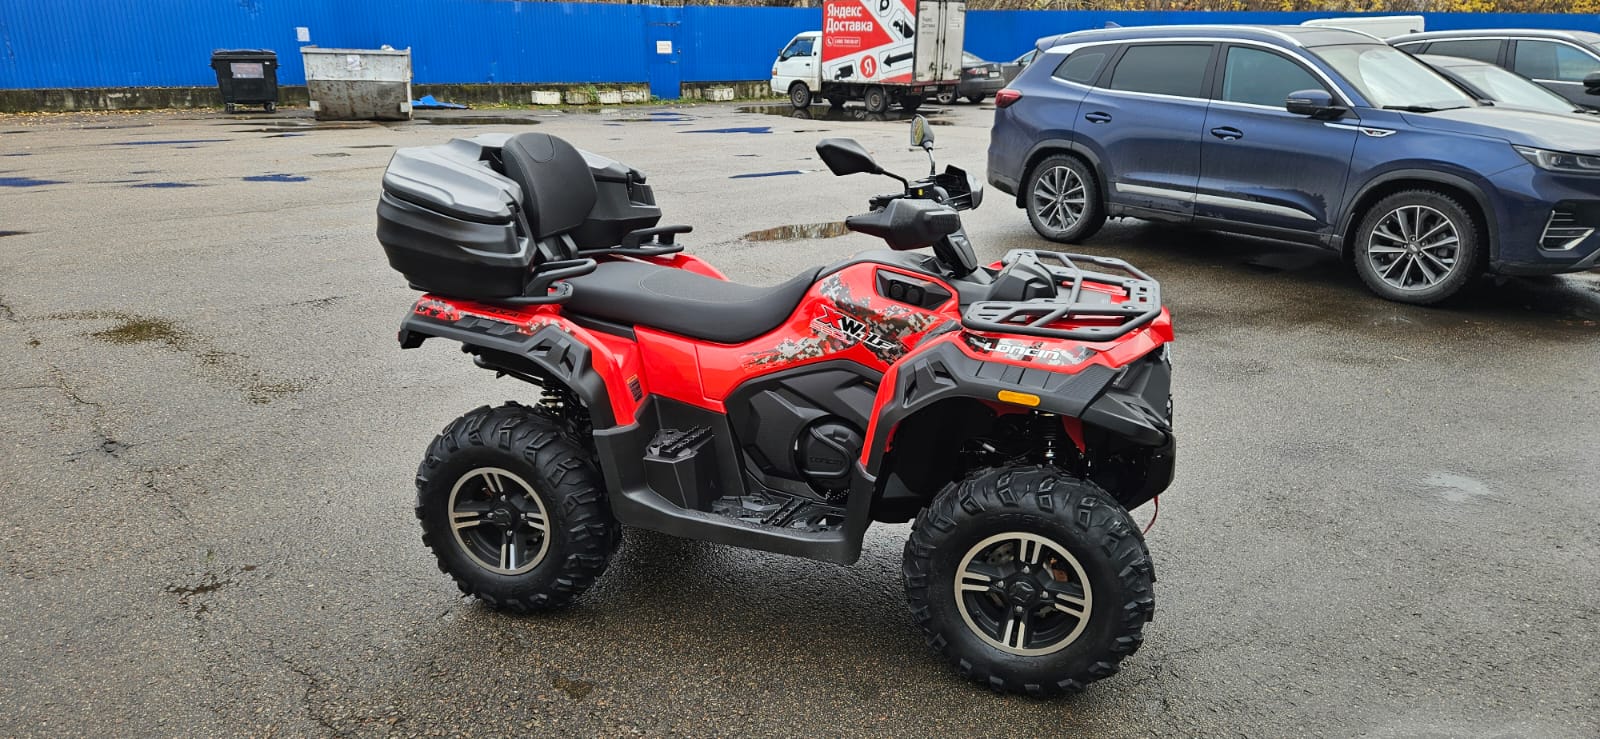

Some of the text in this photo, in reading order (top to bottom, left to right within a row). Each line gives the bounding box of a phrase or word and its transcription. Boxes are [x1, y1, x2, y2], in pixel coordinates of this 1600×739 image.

[827, 3, 862, 17] Яндекс
[826, 19, 873, 32] Доставка
[864, 58, 873, 75] Я
[984, 342, 1059, 360] LONCIN
